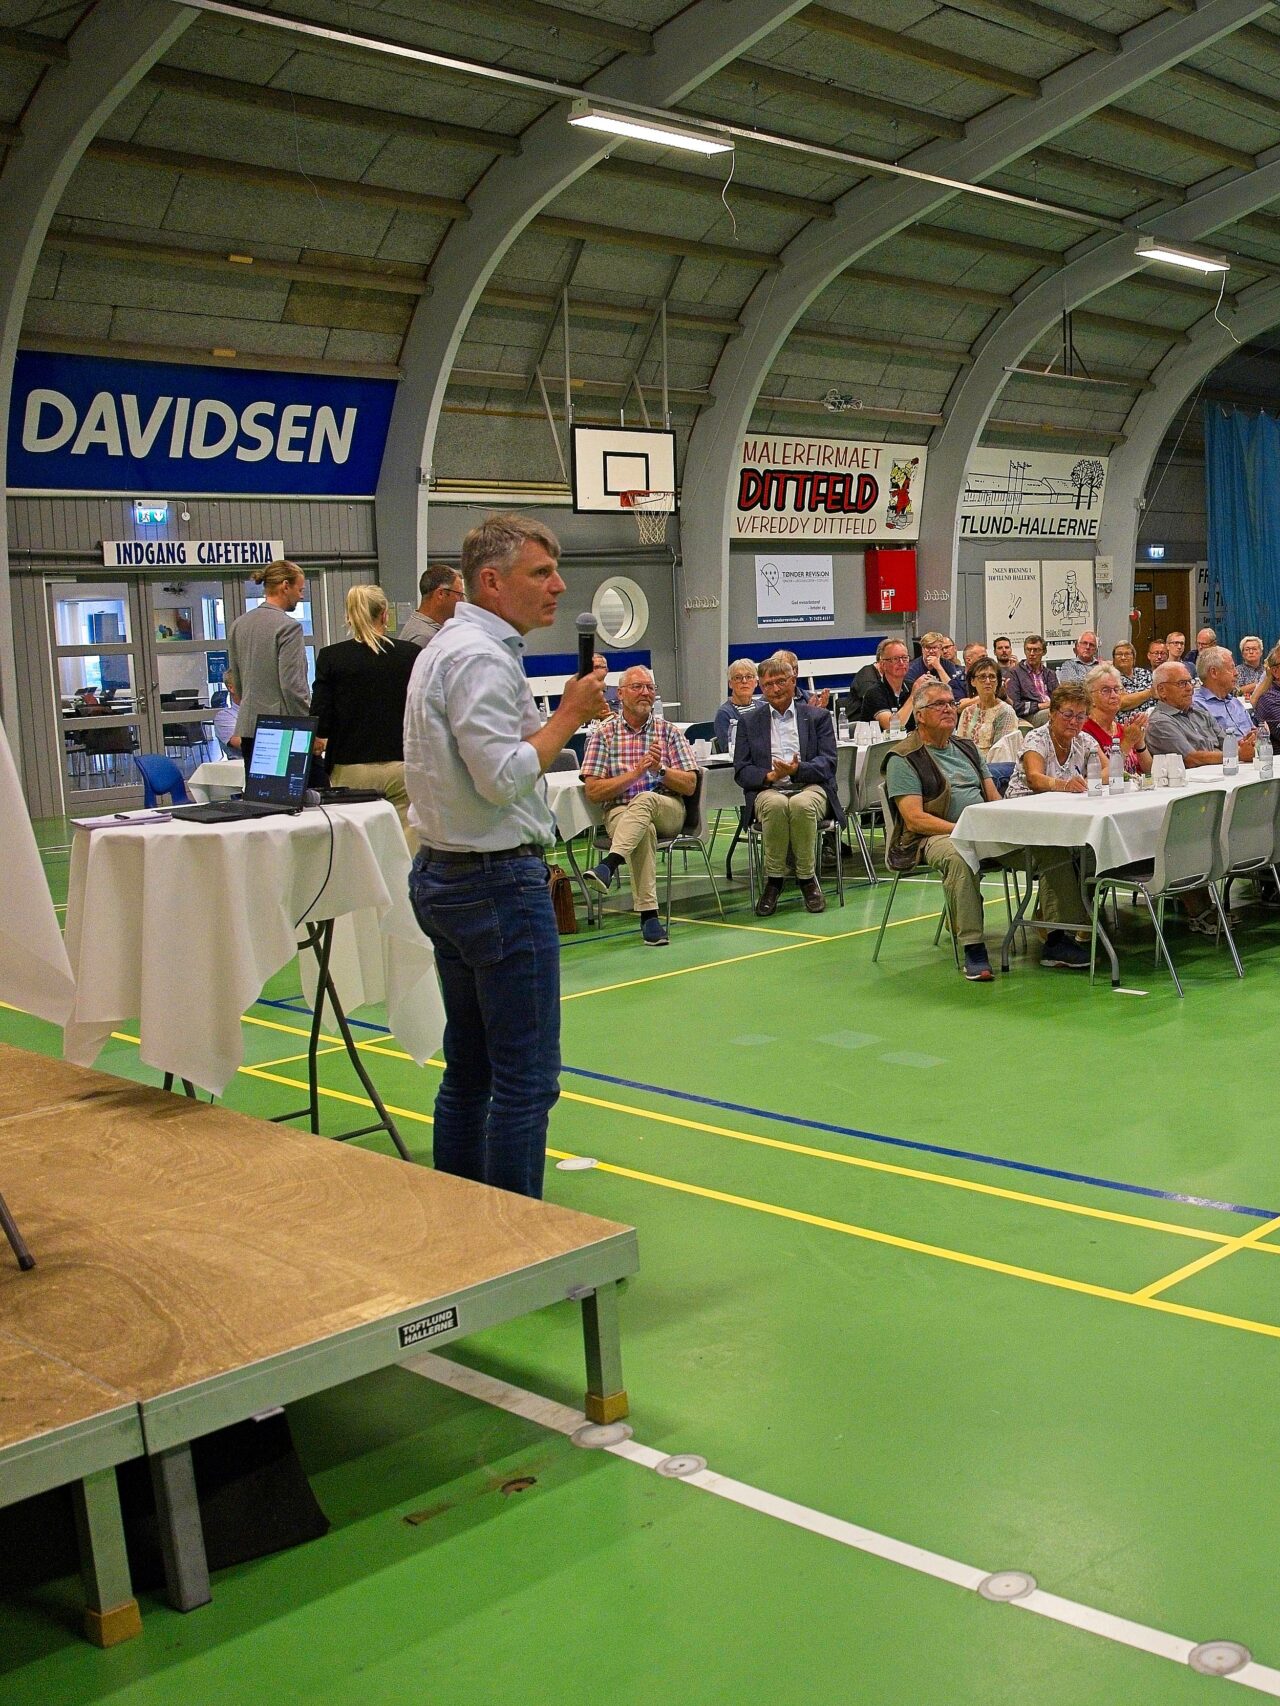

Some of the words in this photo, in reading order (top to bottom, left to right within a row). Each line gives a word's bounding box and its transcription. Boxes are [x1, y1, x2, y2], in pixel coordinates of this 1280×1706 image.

[22, 388, 357, 465] DAVIDSEN
[743, 441, 884, 470] MALERFIRMAET
[737, 467, 879, 514] DITTFELD
[736, 516, 810, 534] V/FREDDY
[814, 517, 877, 535] DITTFELD
[961, 515, 1098, 536] TLUND-HALLERNE
[116, 542, 187, 565] INDGANG
[197, 542, 273, 564] CAFETERIA
[402, 1310, 453, 1336] TOFTLUND
[404, 1319, 454, 1345] HALLERNE
